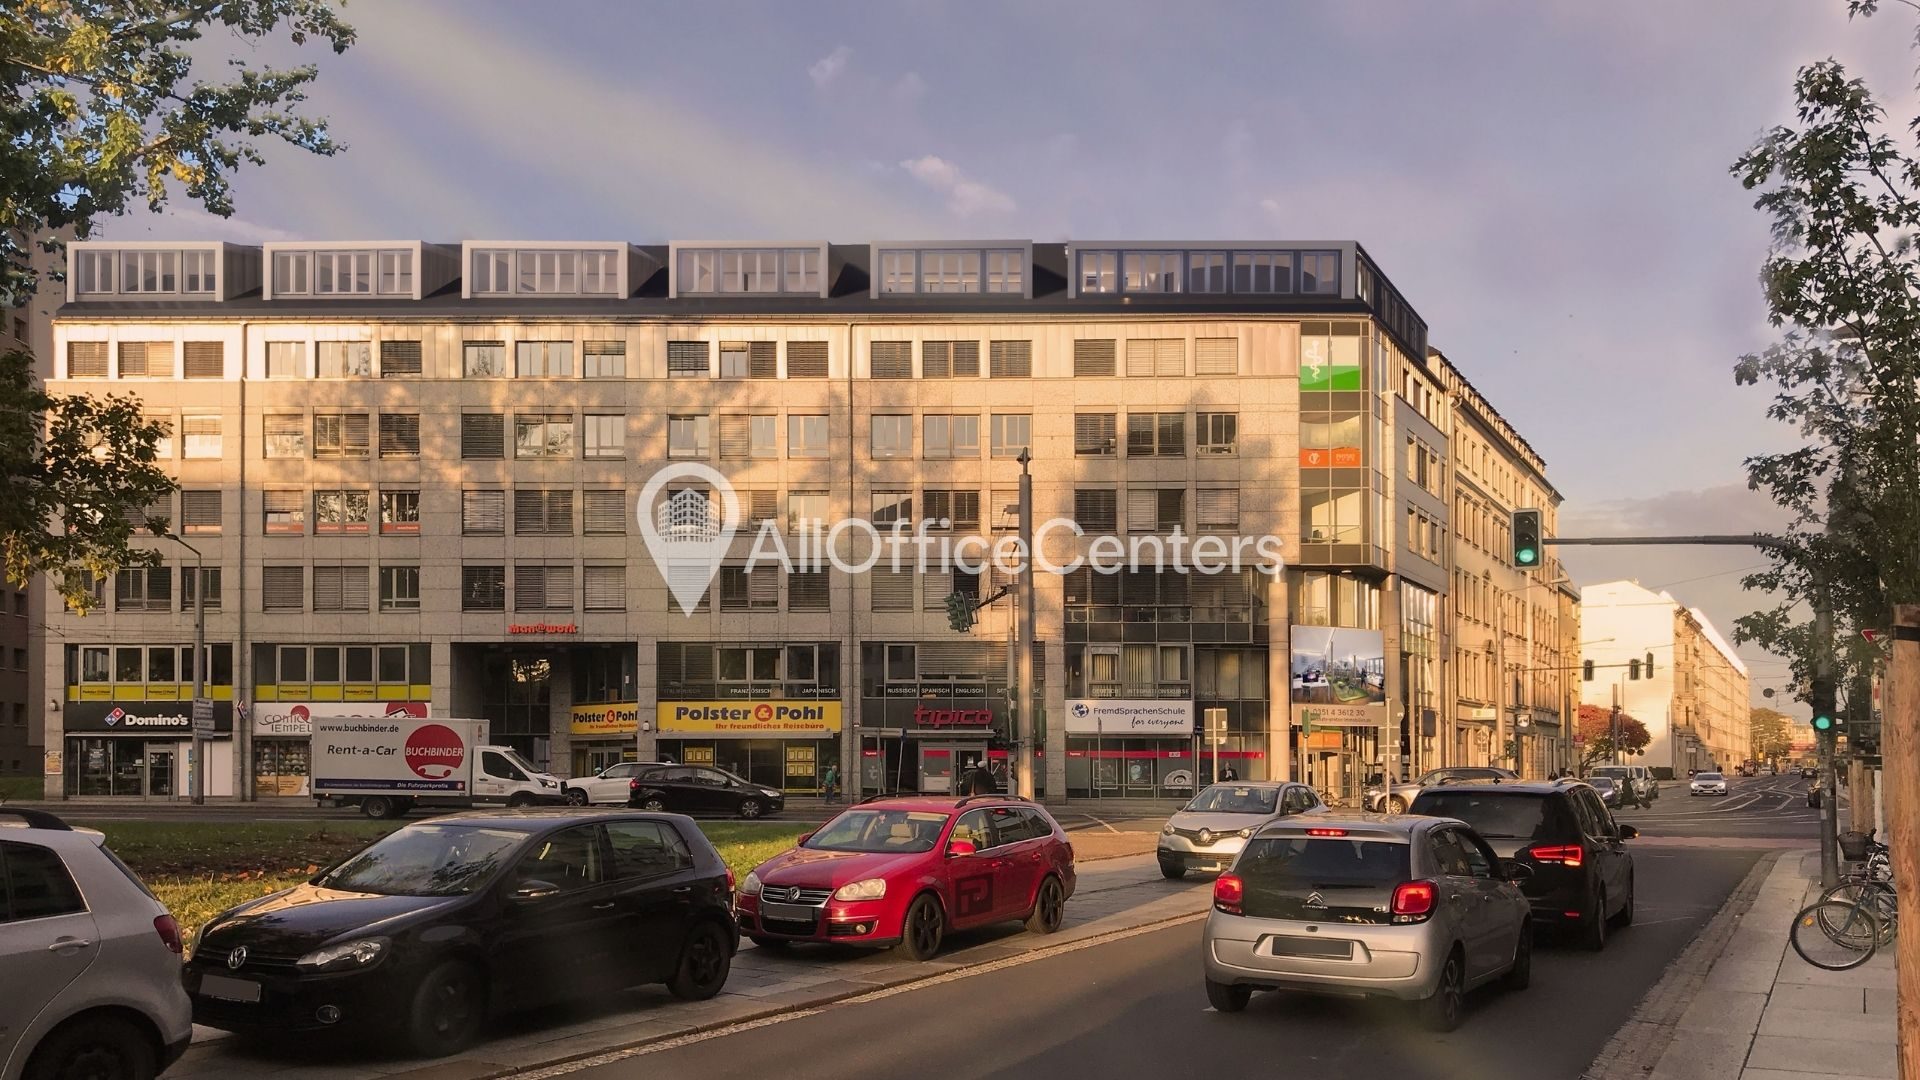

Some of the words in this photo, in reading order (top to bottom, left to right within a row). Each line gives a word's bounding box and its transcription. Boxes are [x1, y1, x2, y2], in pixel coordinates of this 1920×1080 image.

[508, 623, 577, 634] man@work
[573, 712, 606, 723] Polster
[616, 710, 638, 721] Pohl
[676, 706, 752, 721] Polster
[755, 705, 772, 721] &
[776, 706, 824, 720] Pohl
[914, 704, 994, 729] tipico
[1093, 707, 1186, 716] FremdSprachenSchule
[125, 713, 189, 726] Domino's
[1131, 716, 1145, 728] for
[1147, 719, 1184, 728] everyone
[320, 724, 400, 733] www.buchbinder.de
[327, 744, 398, 756] Rent-a-Car
[405, 747, 464, 758] BUCHBINDER
